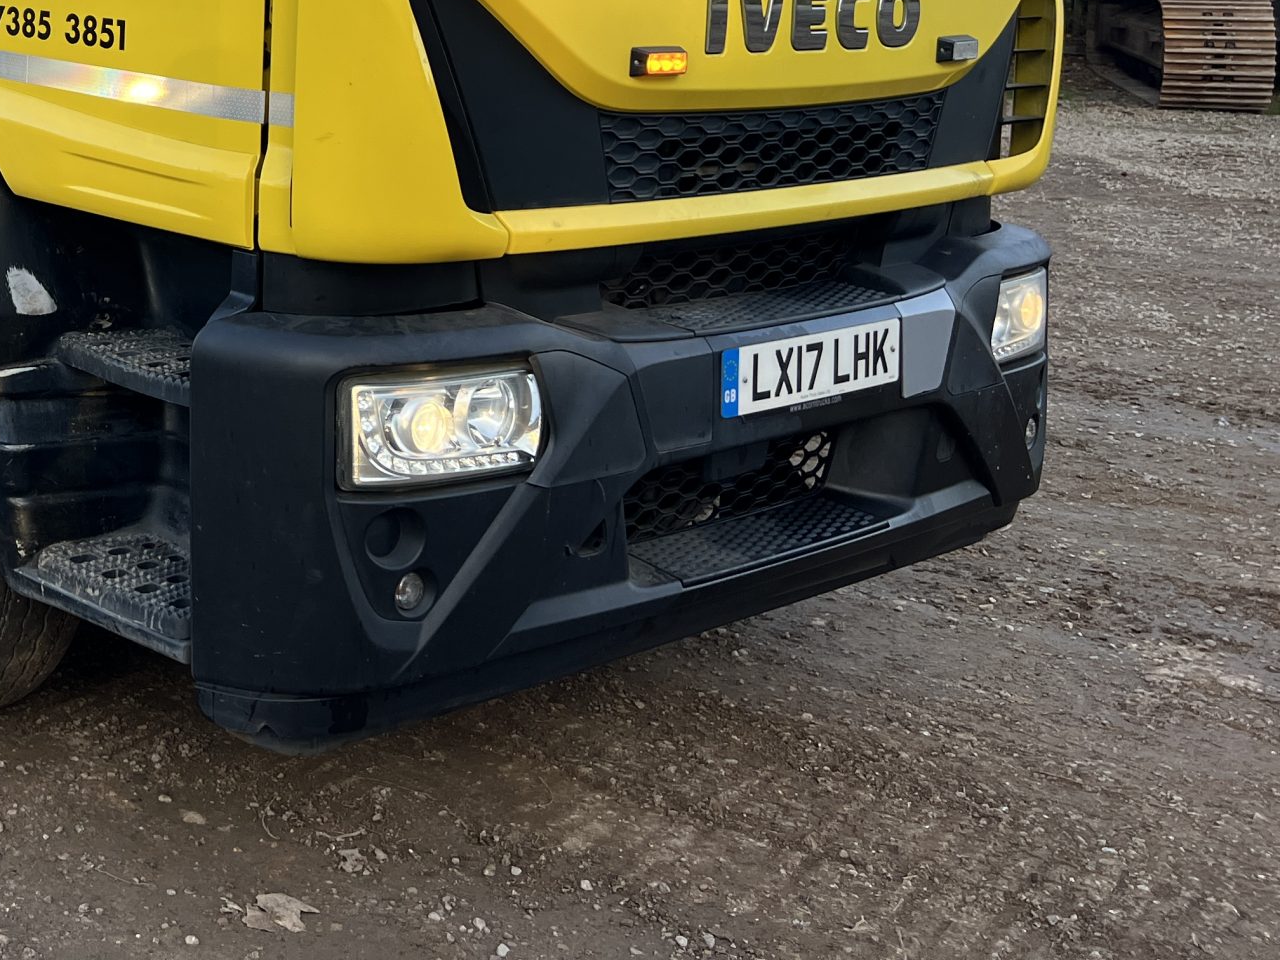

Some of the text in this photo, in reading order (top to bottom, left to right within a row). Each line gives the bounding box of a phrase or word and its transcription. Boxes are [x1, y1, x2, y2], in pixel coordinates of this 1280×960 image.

[64, 12, 127, 52] 3851
[724, 328, 889, 404] GB LX17 LHK
